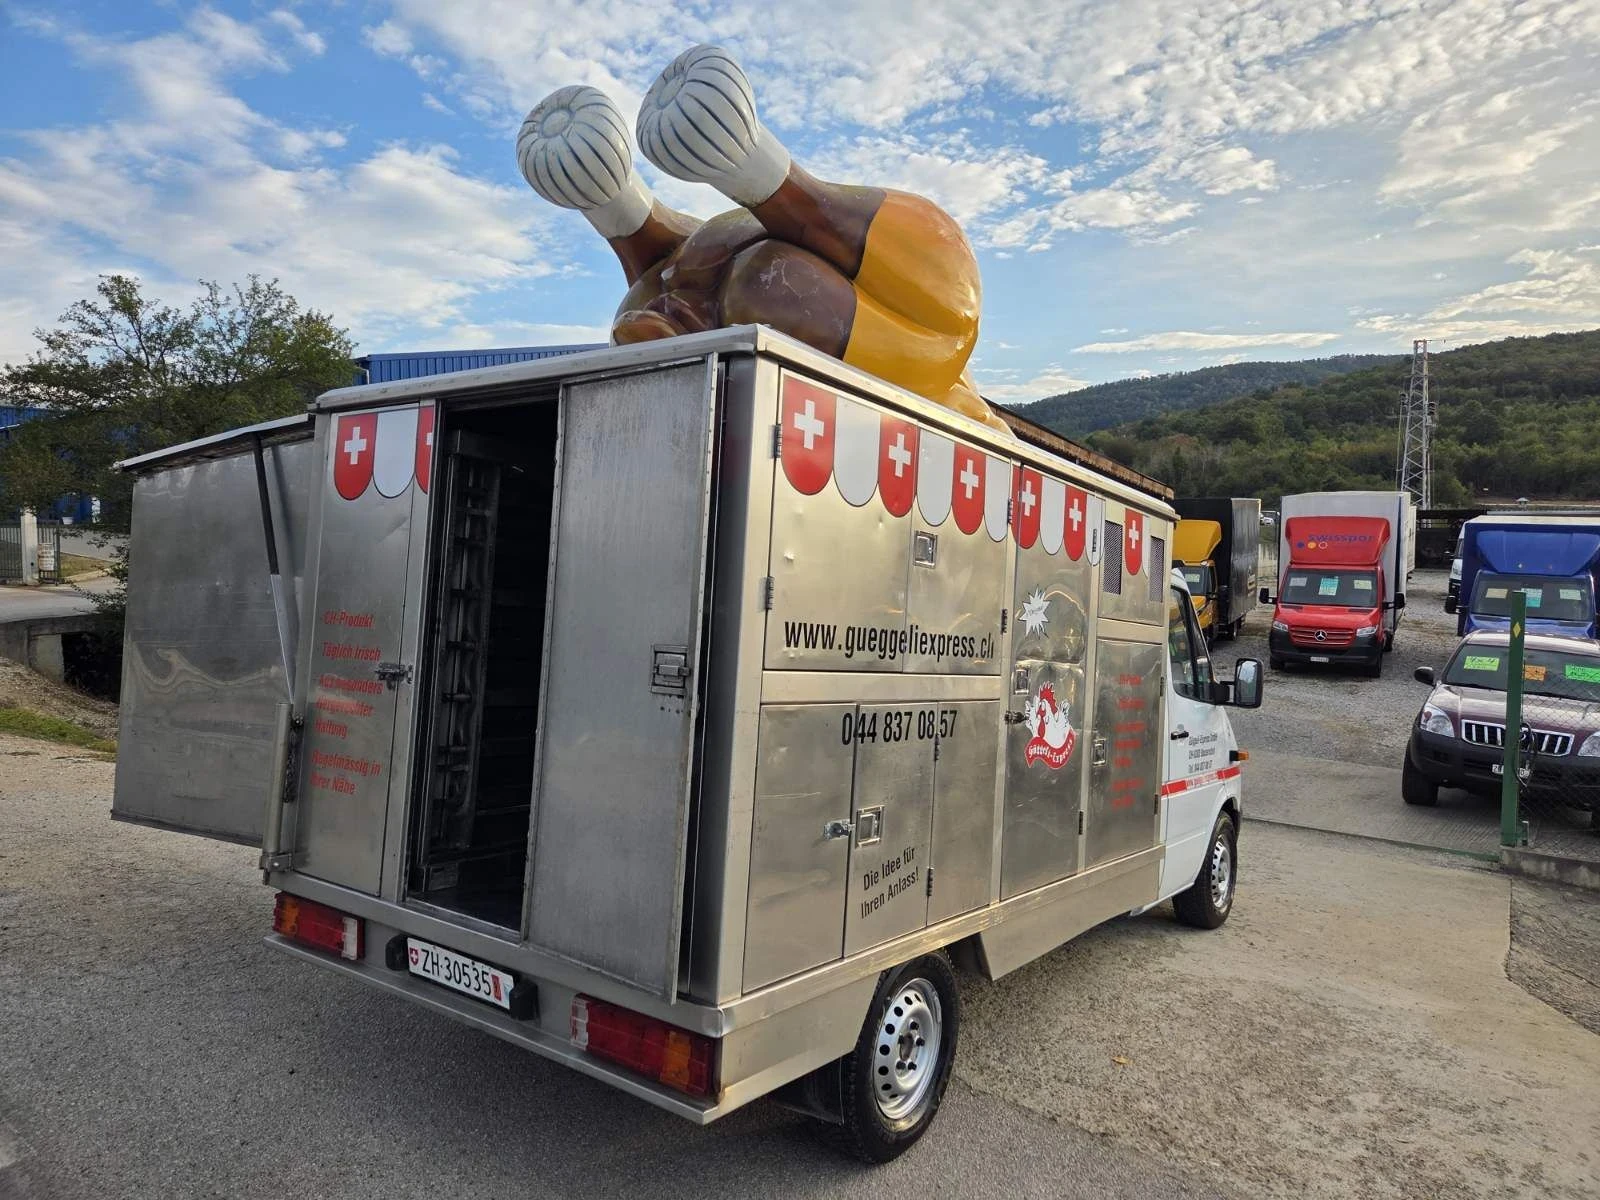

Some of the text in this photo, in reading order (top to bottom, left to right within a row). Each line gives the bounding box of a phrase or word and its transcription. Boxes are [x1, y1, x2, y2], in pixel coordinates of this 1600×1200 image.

[842, 710, 958, 745] 044 837 08 57
[863, 846, 915, 891] Die Idee für
[861, 866, 919, 919] Ihren Anlass!
